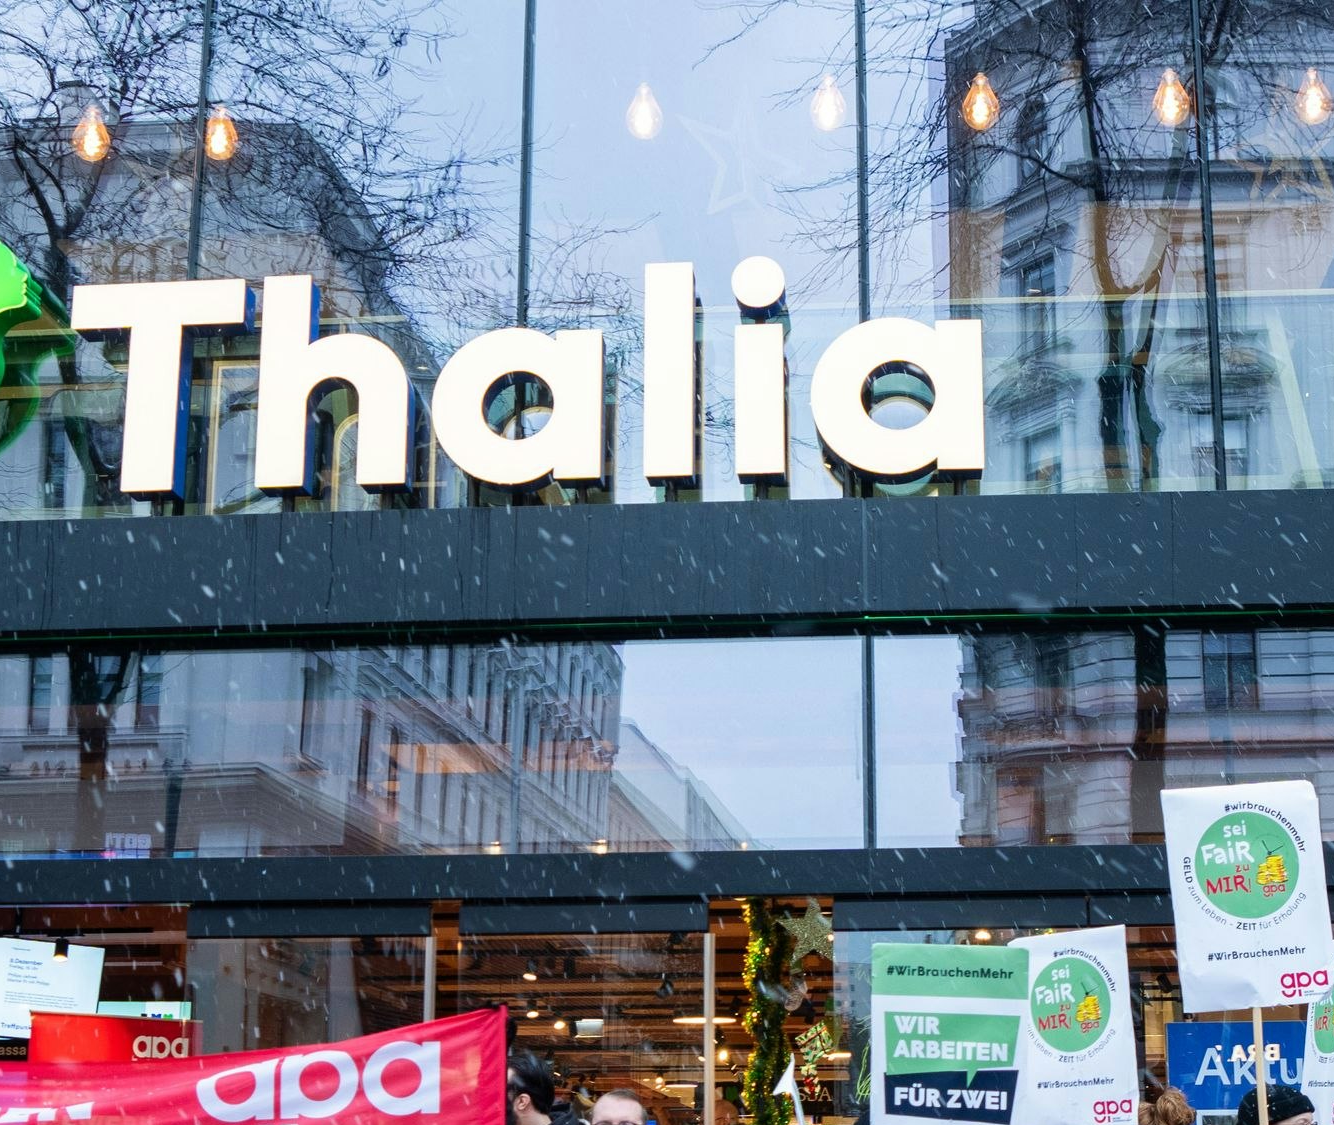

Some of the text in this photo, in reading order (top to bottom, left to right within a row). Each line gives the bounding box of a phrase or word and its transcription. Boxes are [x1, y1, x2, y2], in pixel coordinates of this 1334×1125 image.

[71, 255, 984, 494] Thalia
[1223, 800, 1307, 854] #wirbrauchenmehr
[1223, 820, 1247, 838] sei
[1182, 856, 1193, 885] GELD
[1235, 864, 1250, 873] zu
[1187, 885, 1202, 905] zum
[1206, 874, 1252, 896] MIR!
[1262, 883, 1286, 898] gpa
[1201, 903, 1227, 926] Leben
[1273, 891, 1307, 925] Erholung
[1236, 921, 1257, 931] ZEIT
[1259, 921, 1272, 930] für
[1208, 945, 1306, 962] #WirBrauchenMehr
[886, 965, 1015, 980] #WirBrauchenMehr
[1051, 964, 1070, 982] sei
[1280, 970, 1329, 998] gpa
[893, 1015, 940, 1035] WIR
[1038, 1013, 1072, 1032] MIR!
[893, 1039, 1009, 1062] ARBEITEN
[1058, 1054, 1075, 1063] ZEIT
[1037, 1077, 1115, 1090] #WirBrauchenMehr
[894, 1083, 1008, 1111] FÜR ZWEI
[1093, 1099, 1133, 1124] gpa
